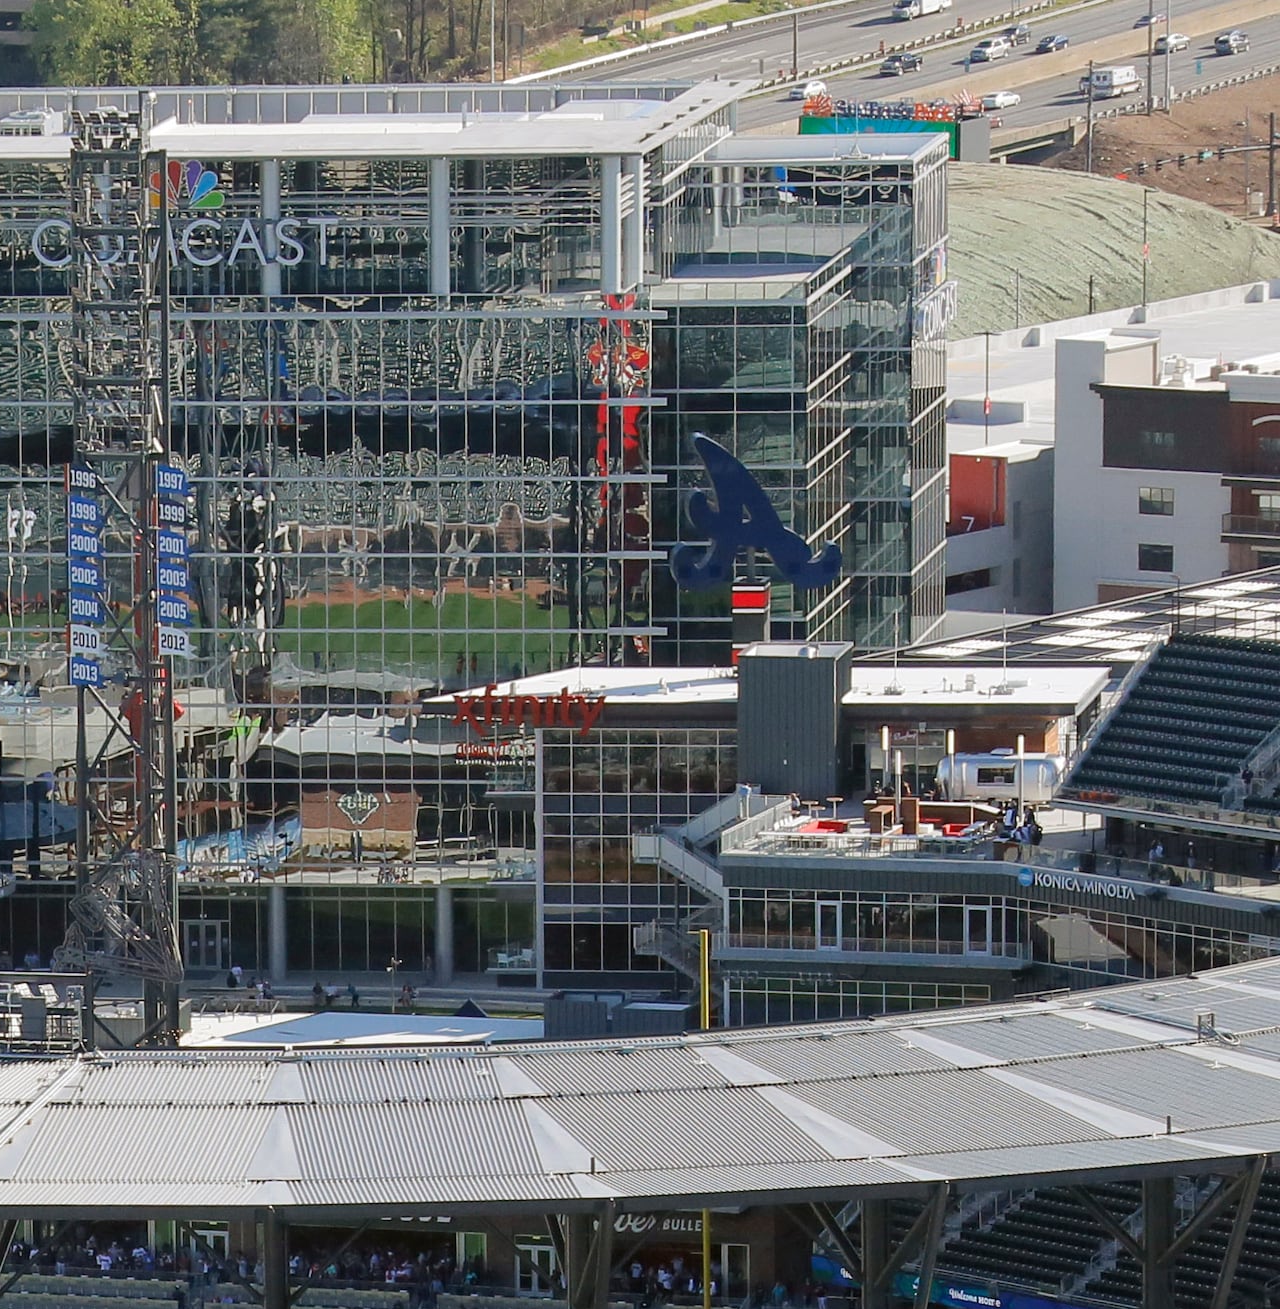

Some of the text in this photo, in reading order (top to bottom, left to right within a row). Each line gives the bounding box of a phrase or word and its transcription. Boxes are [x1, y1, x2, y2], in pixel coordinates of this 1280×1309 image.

[70, 470, 96, 488] 1996
[159, 472, 184, 490] 1997
[71, 503, 96, 520] 1998
[159, 504, 185, 522] 1999
[961, 516, 974, 531] 7
[71, 536, 97, 553] 2000
[160, 537, 184, 555] 2001
[71, 568, 97, 585] 2002
[160, 569, 186, 586] 2003
[72, 600, 98, 617] 2004
[161, 601, 186, 618] 2005
[73, 632, 97, 649] 2010
[161, 634, 185, 651] 2012
[73, 665, 97, 681] 2013
[452, 683, 606, 736] xfinity
[1034, 872, 1136, 901] KONICA MINOLTA
[662, 1217, 704, 1232] BULLE
